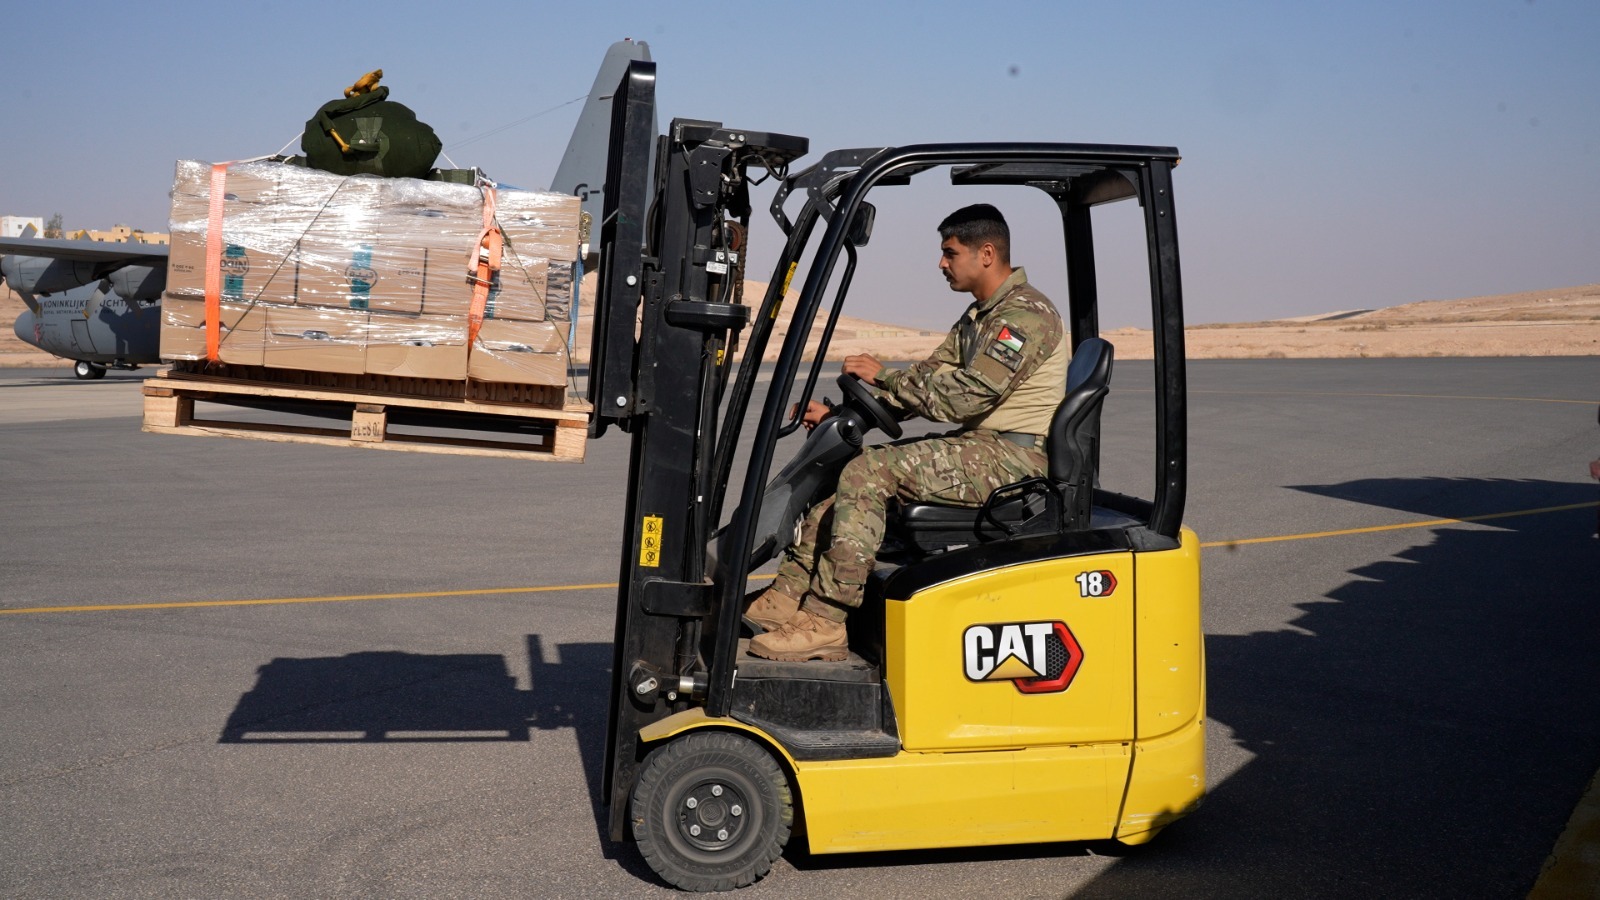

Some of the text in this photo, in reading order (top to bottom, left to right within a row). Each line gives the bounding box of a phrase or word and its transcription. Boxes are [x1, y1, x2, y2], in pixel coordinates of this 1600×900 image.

[574, 183, 606, 202] G-
[1076, 571, 1103, 597] 18
[965, 622, 1053, 680] CAT
